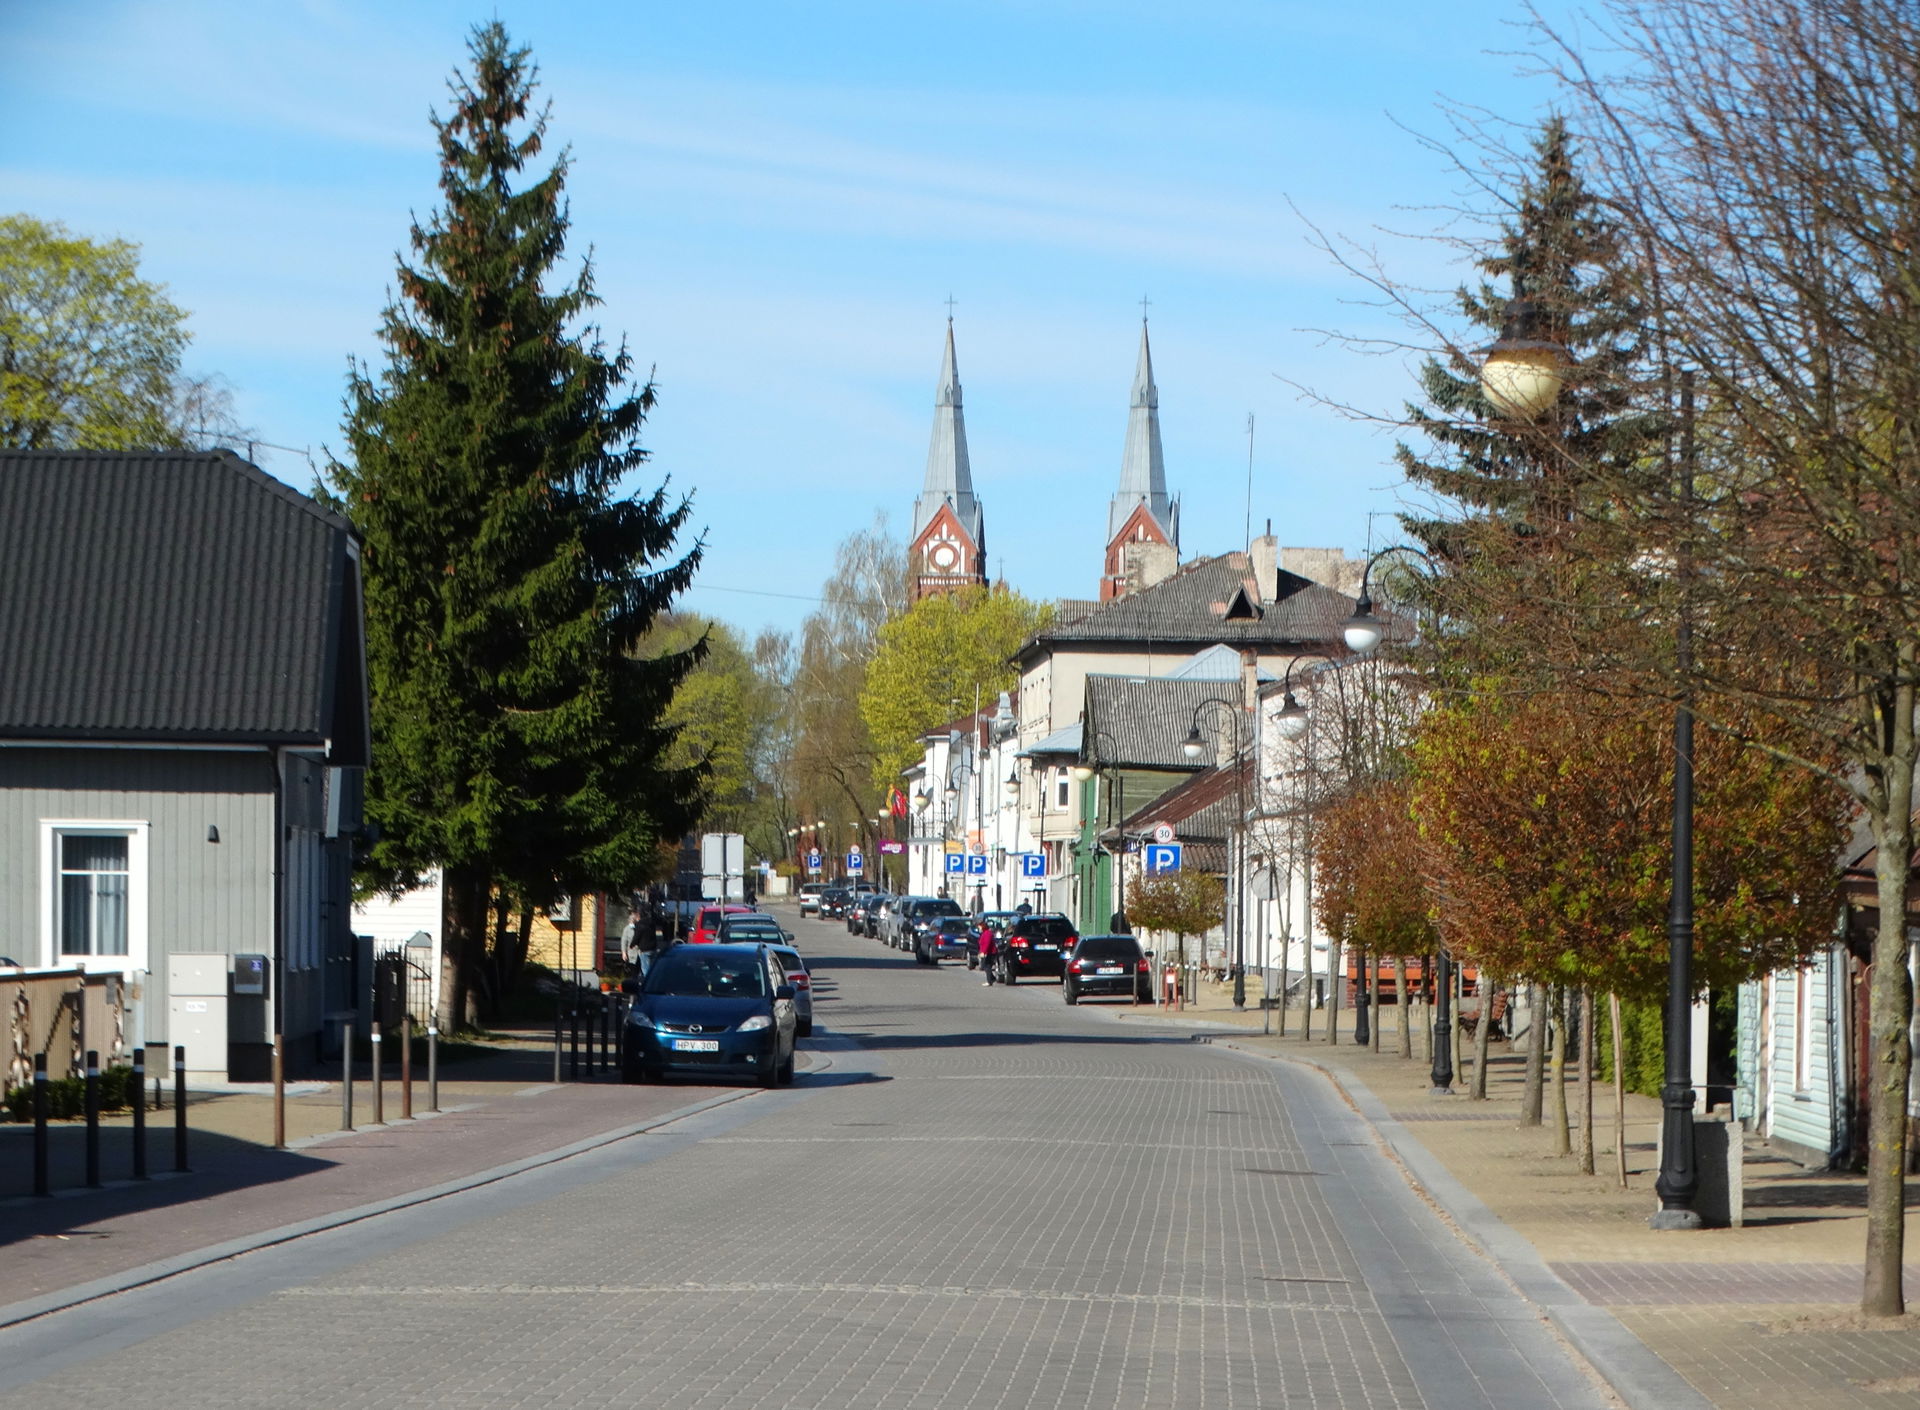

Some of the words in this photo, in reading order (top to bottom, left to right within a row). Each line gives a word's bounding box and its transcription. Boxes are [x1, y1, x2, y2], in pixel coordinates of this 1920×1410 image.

[1159, 830, 1170, 838] 30
[811, 856, 819, 867] P
[851, 855, 860, 867] P
[949, 855, 961, 871] P
[972, 857, 983, 872] P
[1028, 856, 1041, 875] P
[1156, 848, 1174, 876] P
[677, 1041, 696, 1049] HPV
[701, 1042, 717, 1050] 300
